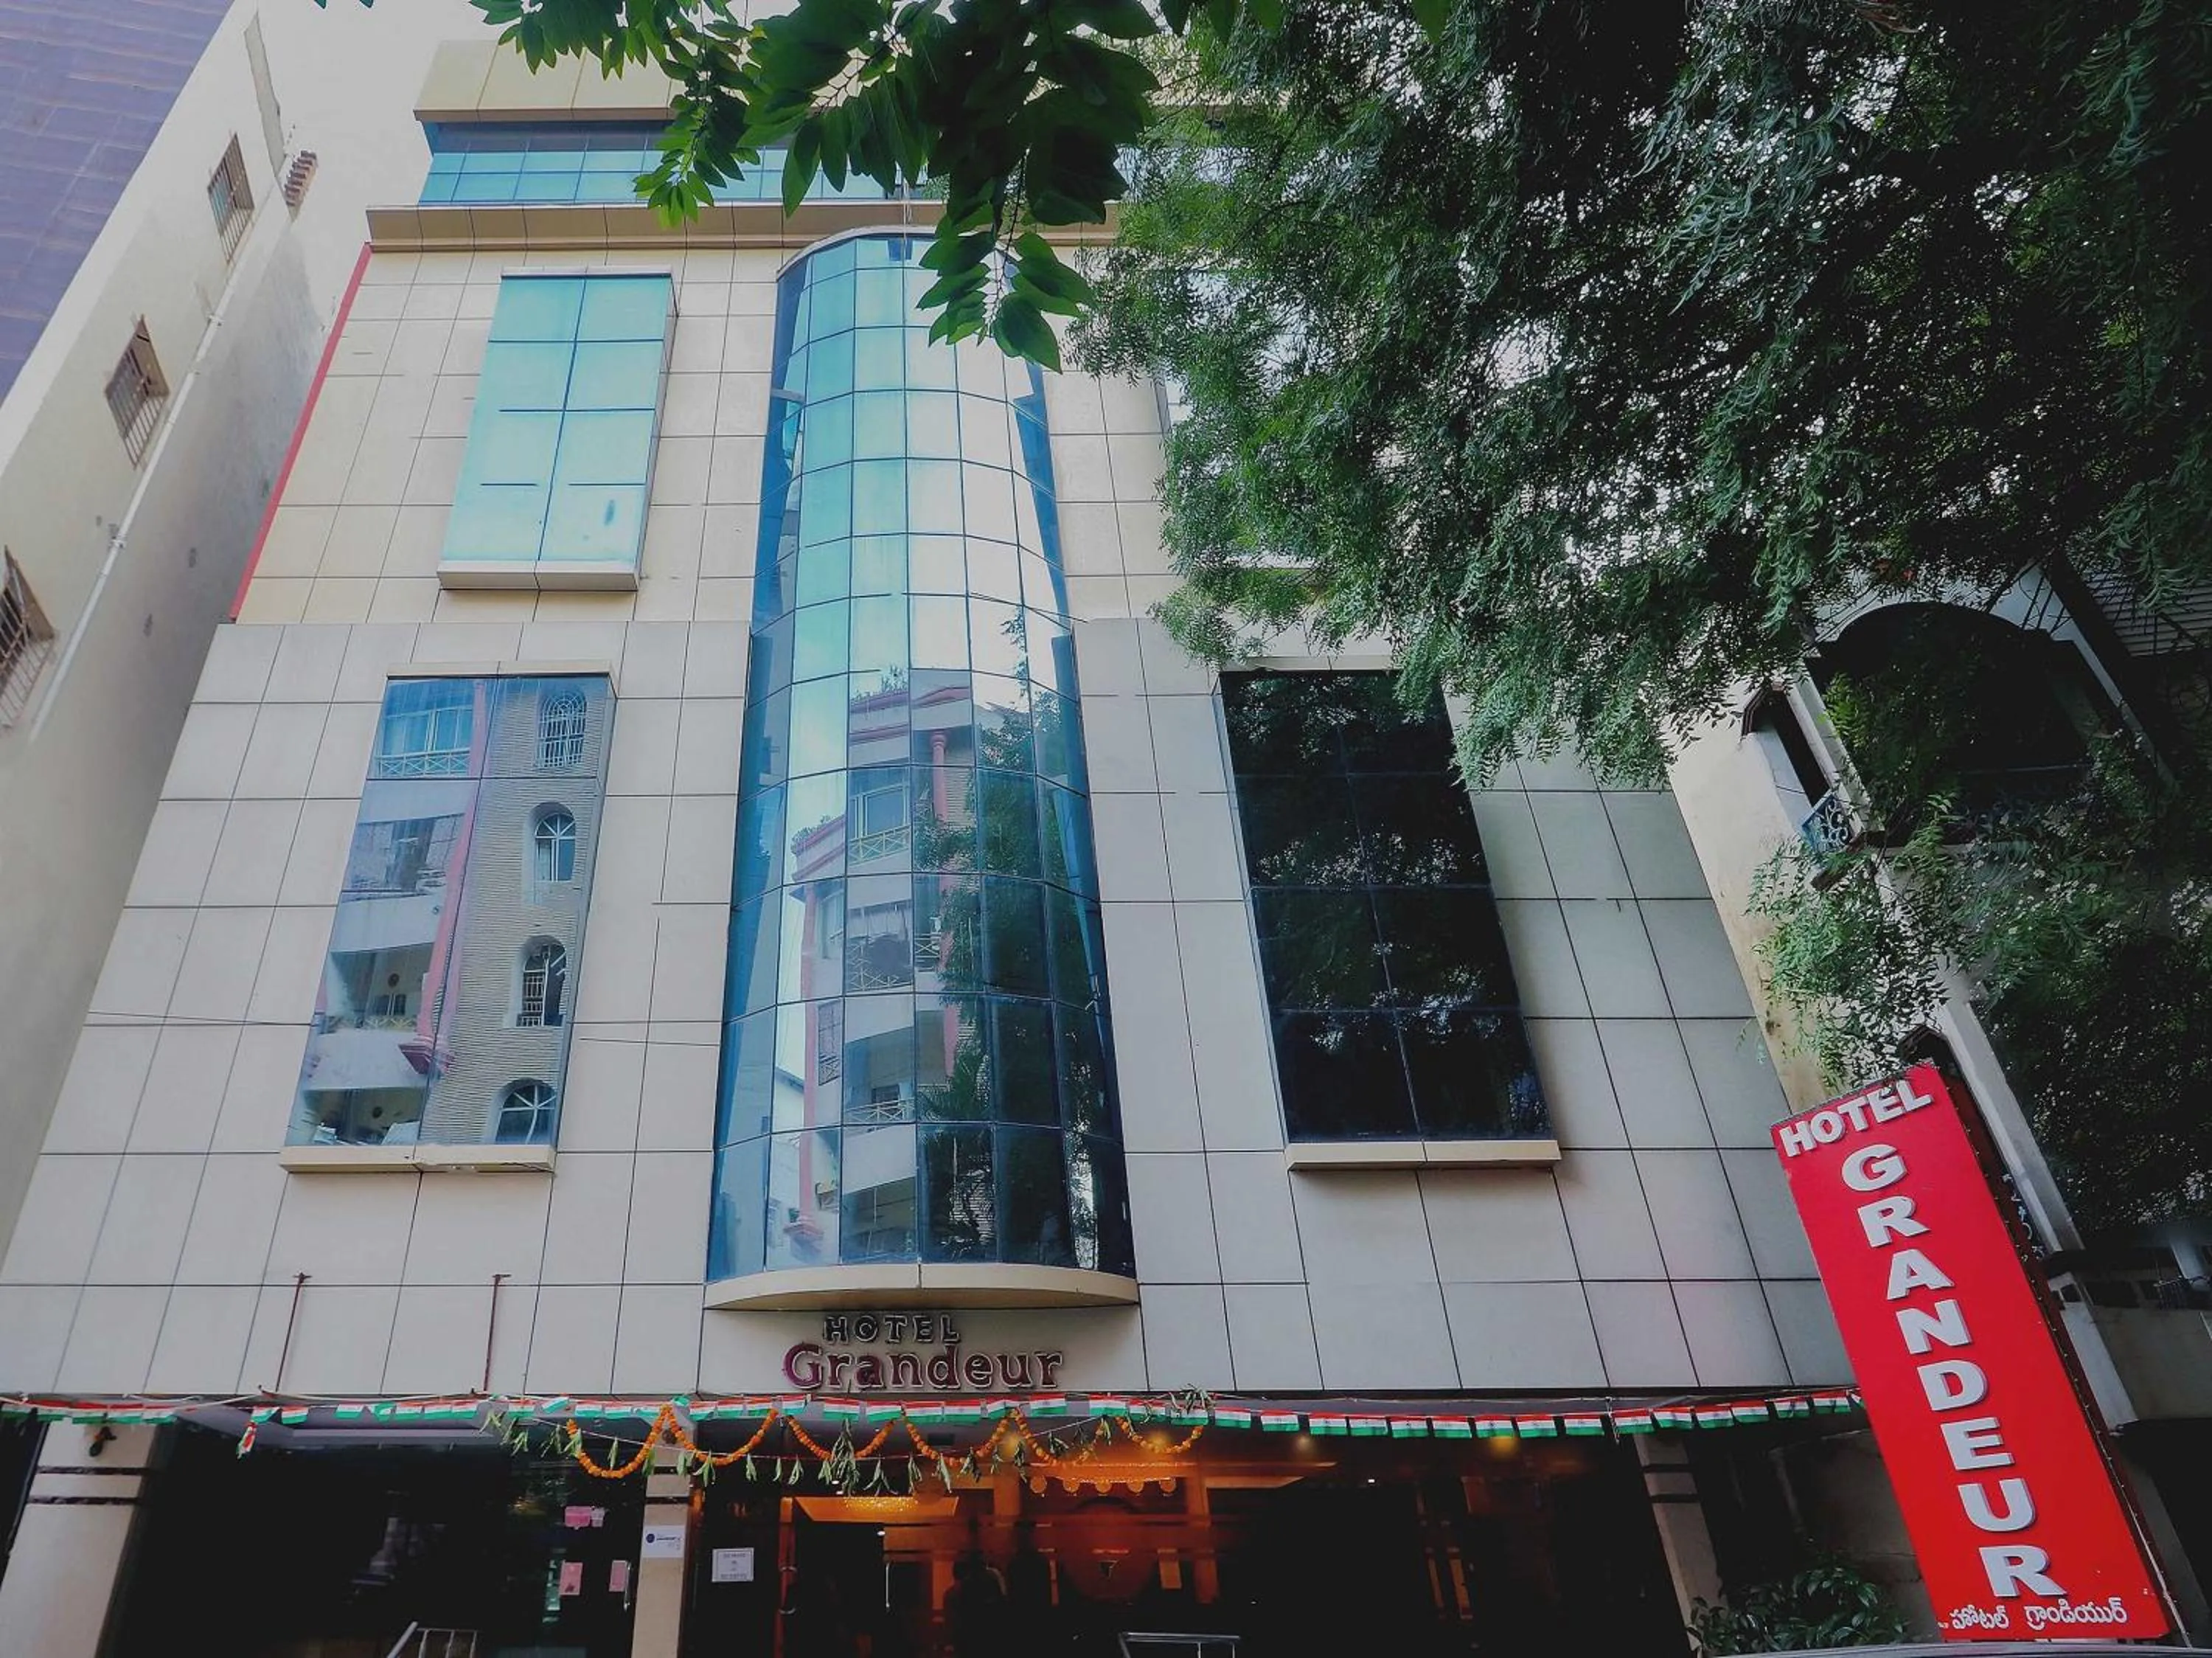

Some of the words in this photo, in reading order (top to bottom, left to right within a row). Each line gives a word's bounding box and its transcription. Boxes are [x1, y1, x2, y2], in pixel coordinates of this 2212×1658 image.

[1779, 1080, 1934, 1157] HOTEL
[823, 1315, 961, 1344] HOTEL
[783, 1343, 1062, 1390] Grandeur
[1841, 1143, 2067, 1598] GRANDEUR
[1950, 1605, 2009, 1629] హోటల్
